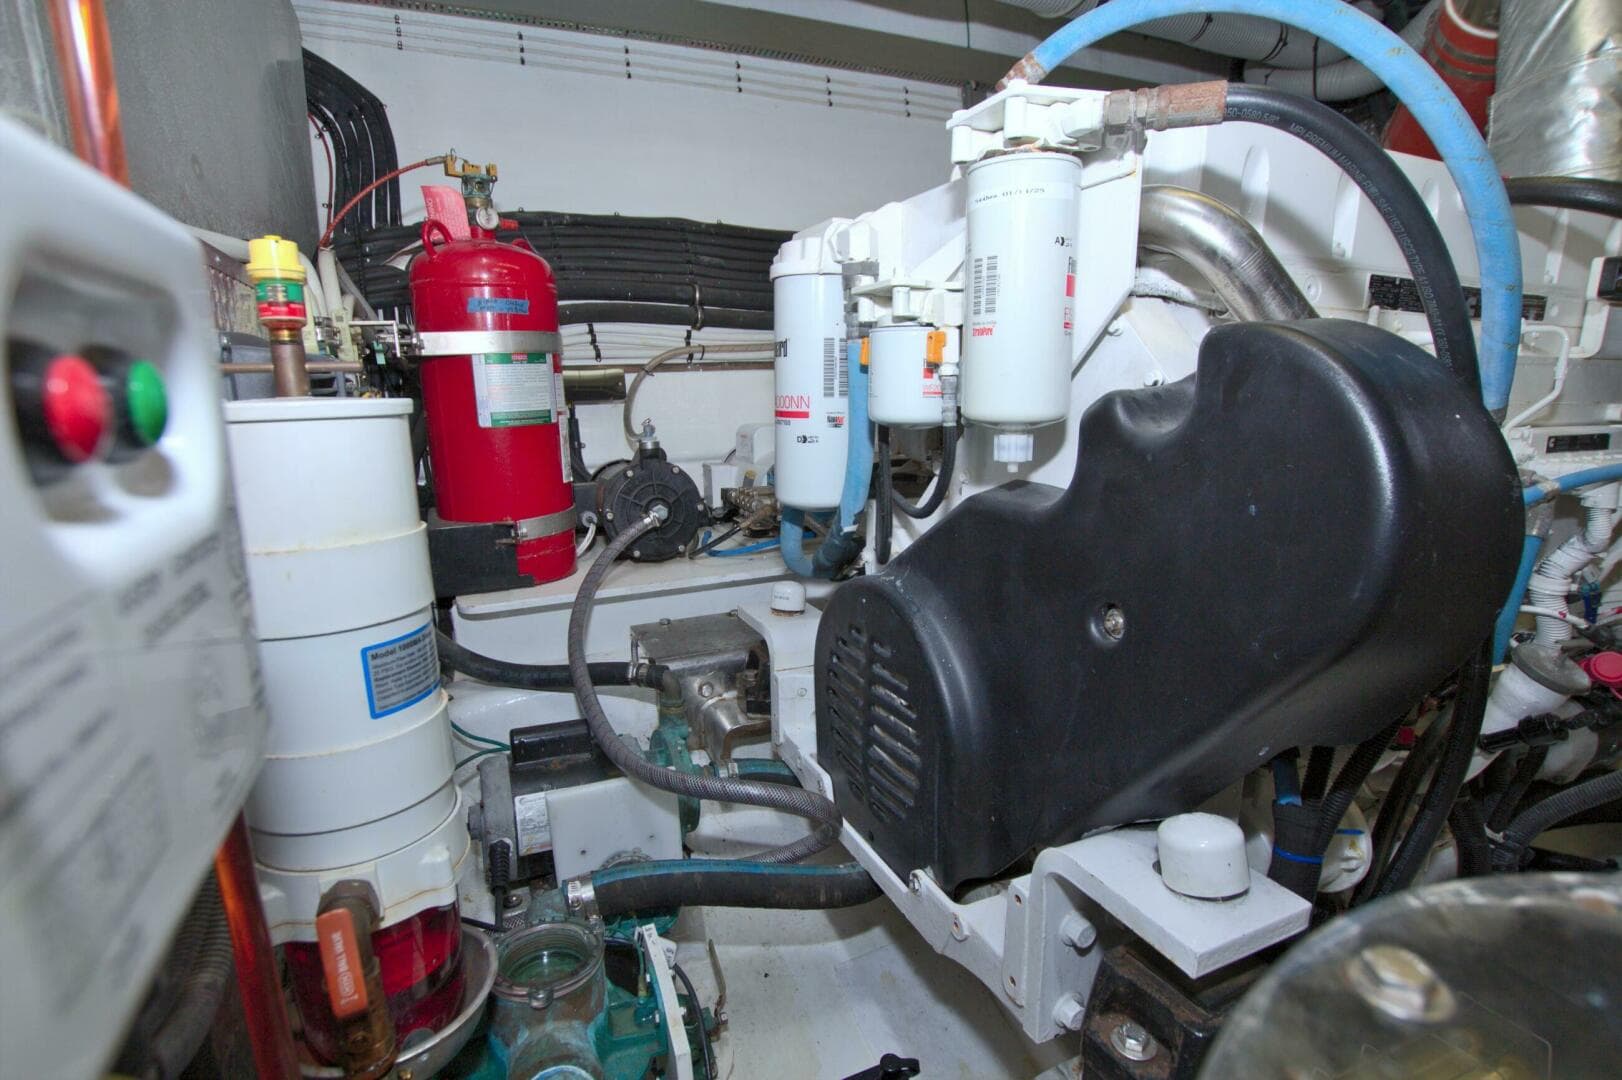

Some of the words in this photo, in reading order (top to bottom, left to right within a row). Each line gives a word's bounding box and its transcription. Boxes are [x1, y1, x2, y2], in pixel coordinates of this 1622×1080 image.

[1304, 129, 1342, 159] PREMIUM
[1361, 178, 1380, 199] FUEL
[1409, 253, 1426, 276] TYPE
[371, 649, 397, 660] Model
